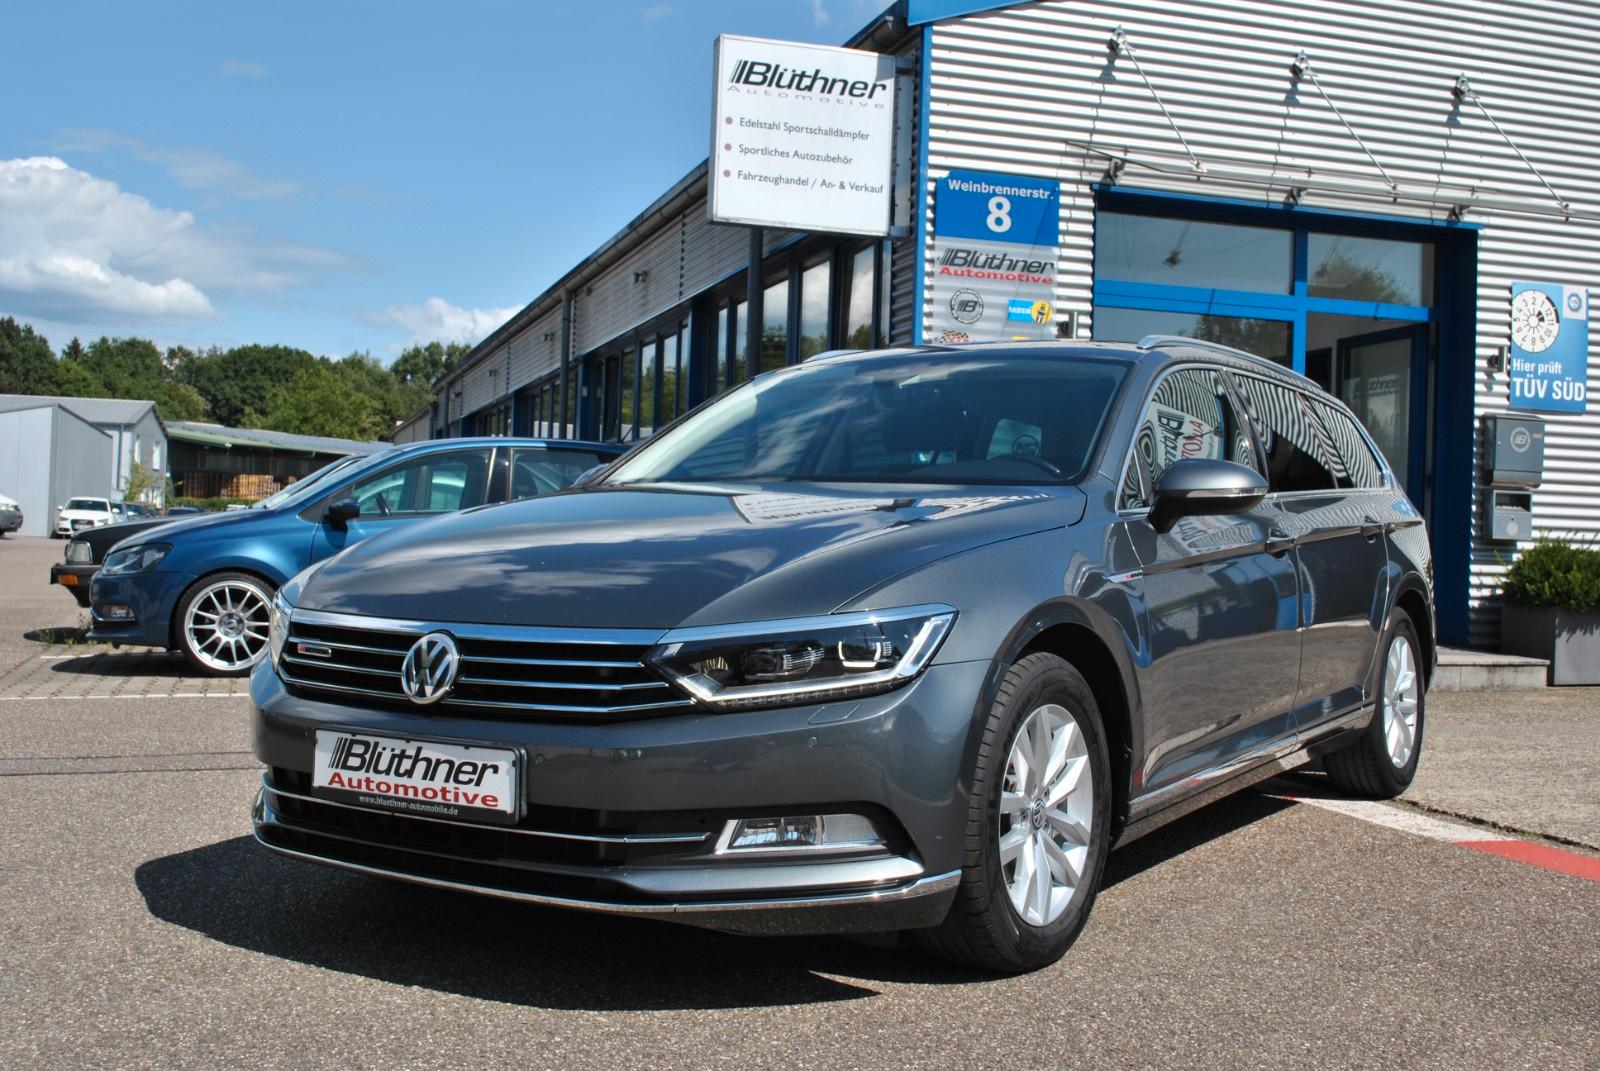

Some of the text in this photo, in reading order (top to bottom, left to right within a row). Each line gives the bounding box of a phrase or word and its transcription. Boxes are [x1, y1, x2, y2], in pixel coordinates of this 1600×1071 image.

[733, 59, 886, 99] Blüthner
[727, 85, 885, 110] Automotive
[739, 117, 870, 142] Edelstahl Sportschalldämpfer
[738, 144, 853, 165] Sportliches Autozubehör
[737, 170, 809, 187] Fahrzeughandel
[820, 179, 836, 189] An-
[839, 181, 846, 190] &
[849, 181, 884, 194] Verkauf
[948, 179, 1053, 200] Weinbrennerstr.
[986, 196, 1012, 233] 8
[941, 248, 1054, 274] Blüthner
[939, 267, 1053, 285] Automotive
[1531, 297, 1537, 306] 2
[1531, 337, 1537, 346] 8
[1512, 358, 1562, 376] Hier prüft
[1512, 374, 1585, 401] TÜV SÜD
[331, 737, 499, 787] Blüthner
[327, 772, 499, 808] Automotive
